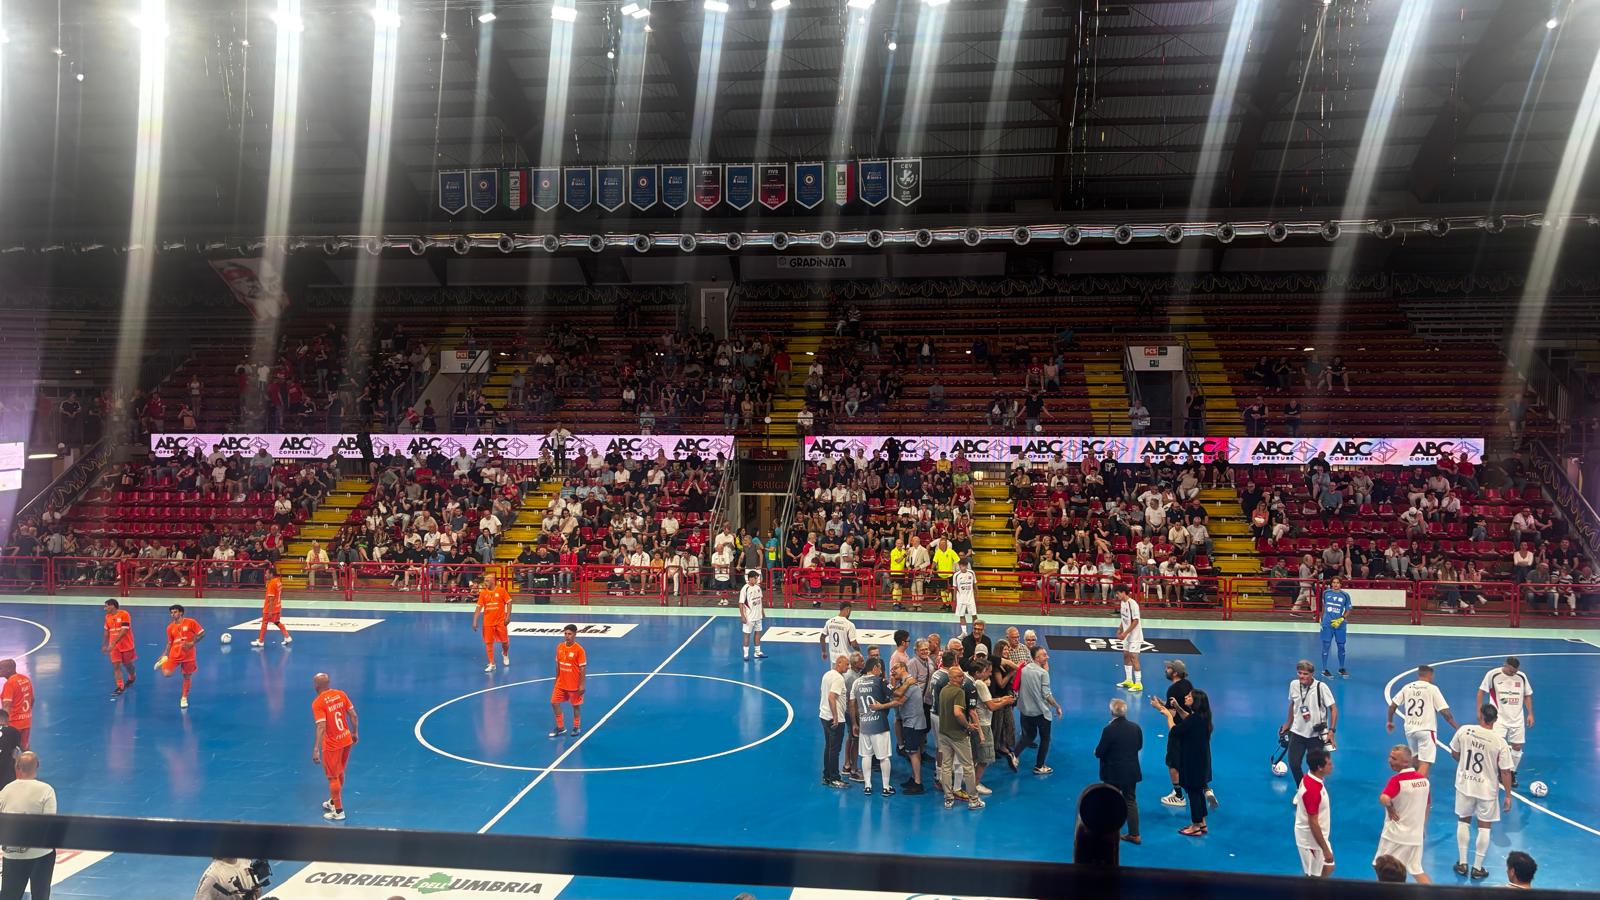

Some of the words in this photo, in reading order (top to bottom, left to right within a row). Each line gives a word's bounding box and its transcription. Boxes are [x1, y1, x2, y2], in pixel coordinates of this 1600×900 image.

[154, 436, 188, 449] ABC
[218, 436, 250, 449] ABC
[280, 436, 312, 450] ABC
[407, 437, 442, 451] ABC
[472, 437, 508, 451] ABC
[606, 438, 642, 451] ABC
[673, 438, 710, 452] ABC
[809, 439, 846, 453] ABC
[950, 440, 989, 453] ABC
[1024, 440, 1063, 454] ABC
[1252, 441, 1294, 456] ABC
[1329, 441, 1372, 456] ABC
[1410, 442, 1454, 456] ABC
[752, 481, 789, 489] PERUGIA
[833, 632, 839, 647] 9
[1407, 698, 1425, 717] 23
[334, 711, 344, 731] 6
[1465, 749, 1484, 774] 18
[305, 871, 417, 889] CORRIERE
[448, 878, 543, 894] UMBRIA
